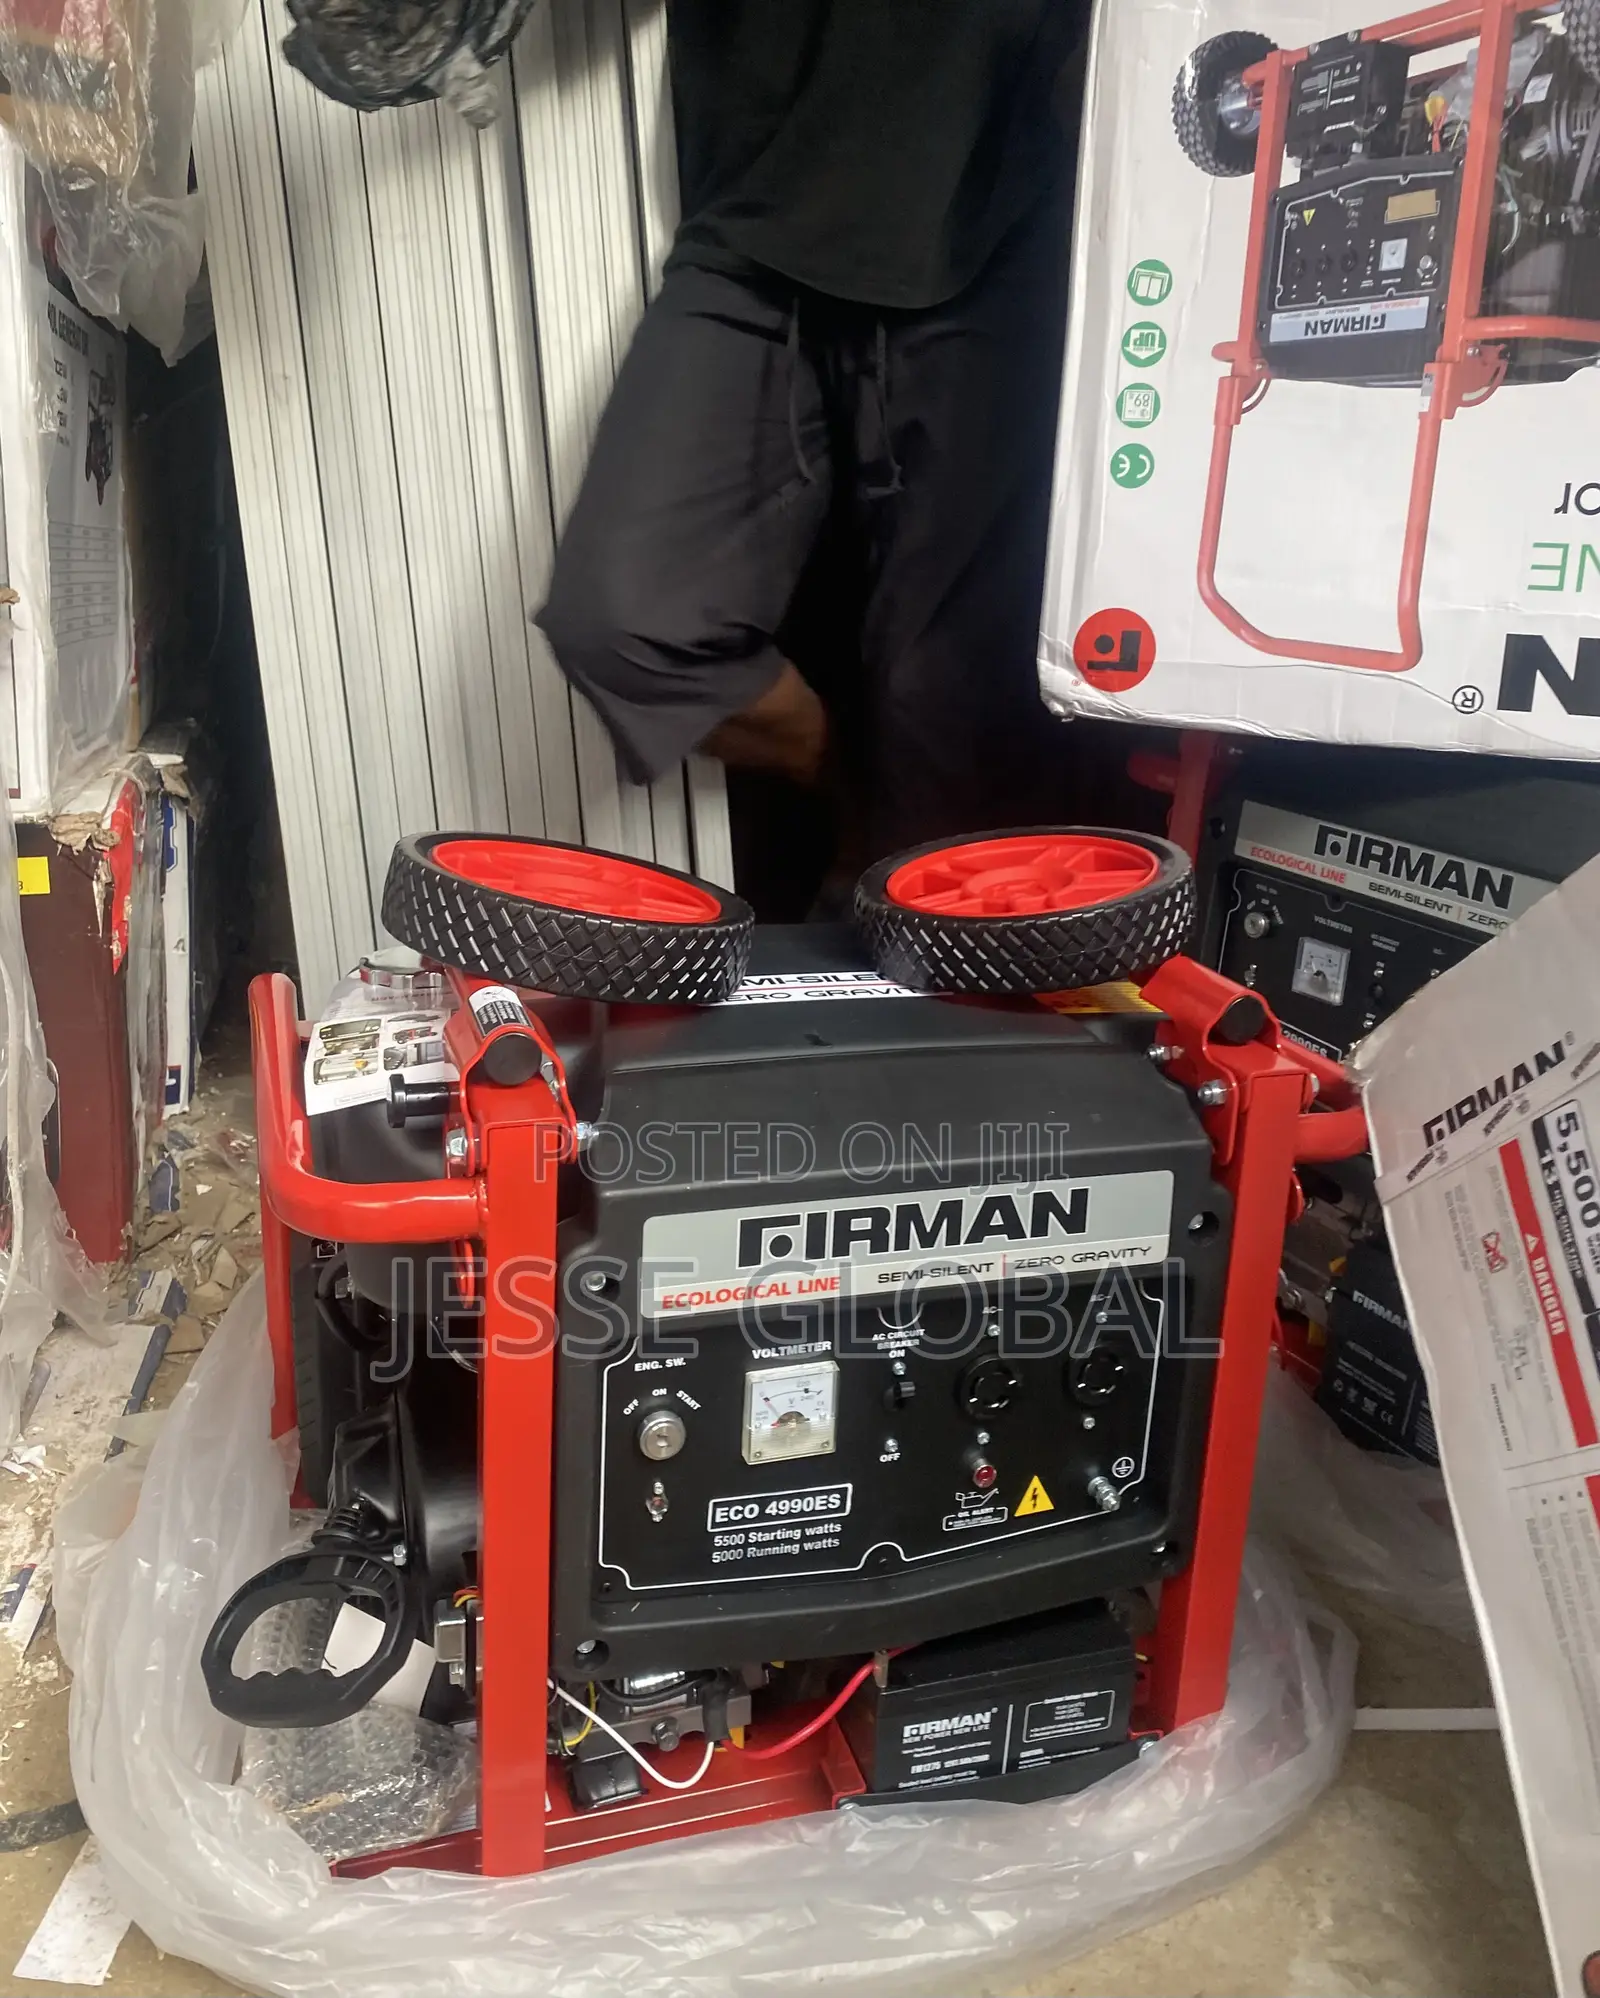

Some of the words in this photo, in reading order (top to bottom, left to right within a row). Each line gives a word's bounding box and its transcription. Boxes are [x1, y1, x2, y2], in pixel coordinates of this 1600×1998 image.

[1303, 313, 1387, 337] FIRMAN
[1133, 331, 1157, 347] UP
[1250, 846, 1319, 877] ECOLOGICAL
[1319, 865, 1348, 885] LINE
[1313, 823, 1516, 910] FIRMAN
[1368, 882, 1453, 914] SEMI-SILENT
[804, 987, 919, 998] GRAVIT
[1422, 1040, 1566, 1148] FIRMAN
[1556, 1111, 1600, 1228] 5,500
[737, 1187, 1091, 1269] FIRMAN
[661, 1280, 791, 1310] ECOLOGICAL
[797, 1276, 841, 1294] LINE
[877, 1262, 995, 1283] SEMI-SILENT
[1014, 1254, 1065, 1269] ZERO
[1071, 1246, 1152, 1263] GRAVITY
[1532, 1256, 1566, 1336] DANGER
[872, 1333, 886, 1341] AC
[887, 1329, 925, 1340] CIRCUIT
[752, 1340, 833, 1360] VOLTMETER
[889, 1349, 905, 1359] ON
[634, 1361, 663, 1371] ENG.
[665, 1357, 687, 1368] SW.
[652, 1388, 667, 1396] ON
[676, 1390, 702, 1410] START
[623, 1399, 640, 1415] OFF
[879, 1453, 901, 1462] OFF
[715, 1503, 760, 1523] ECO
[765, 1493, 842, 1516] 4990ES
[713, 1533, 745, 1547] 5500
[748, 1528, 802, 1544] Starting
[804, 1522, 842, 1536] watts
[711, 1549, 744, 1563] 5000
[746, 1543, 800, 1558] Running
[803, 1537, 840, 1551] watts
[902, 1736, 921, 1745] NEW
[922, 1730, 952, 1740] POWER
[953, 1726, 971, 1735] NEW
[972, 1723, 990, 1732] LIFE
[903, 1711, 992, 1738] FIRMAN
